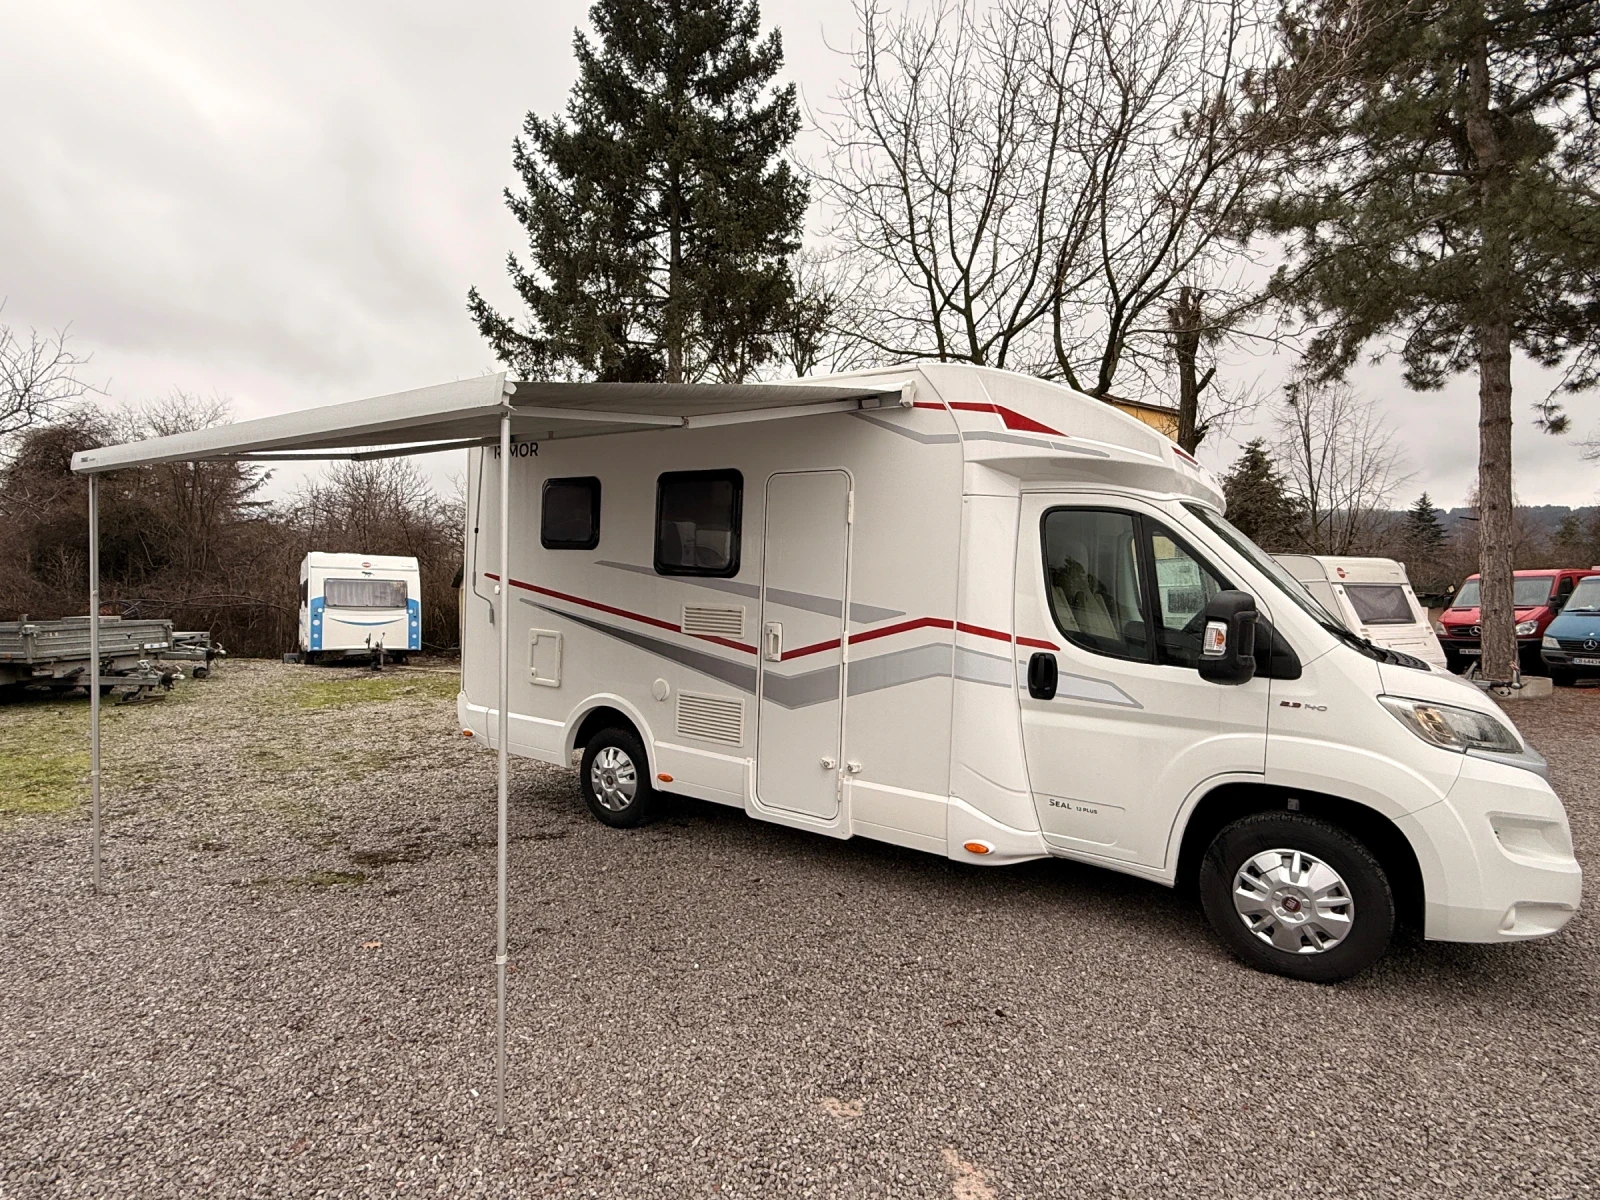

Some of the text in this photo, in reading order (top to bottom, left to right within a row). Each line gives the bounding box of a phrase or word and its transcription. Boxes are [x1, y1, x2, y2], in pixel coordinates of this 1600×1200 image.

[494, 442, 539, 460] RMOR
[1049, 798, 1072, 810] SEAL
[1083, 807, 1098, 815] PLUS
